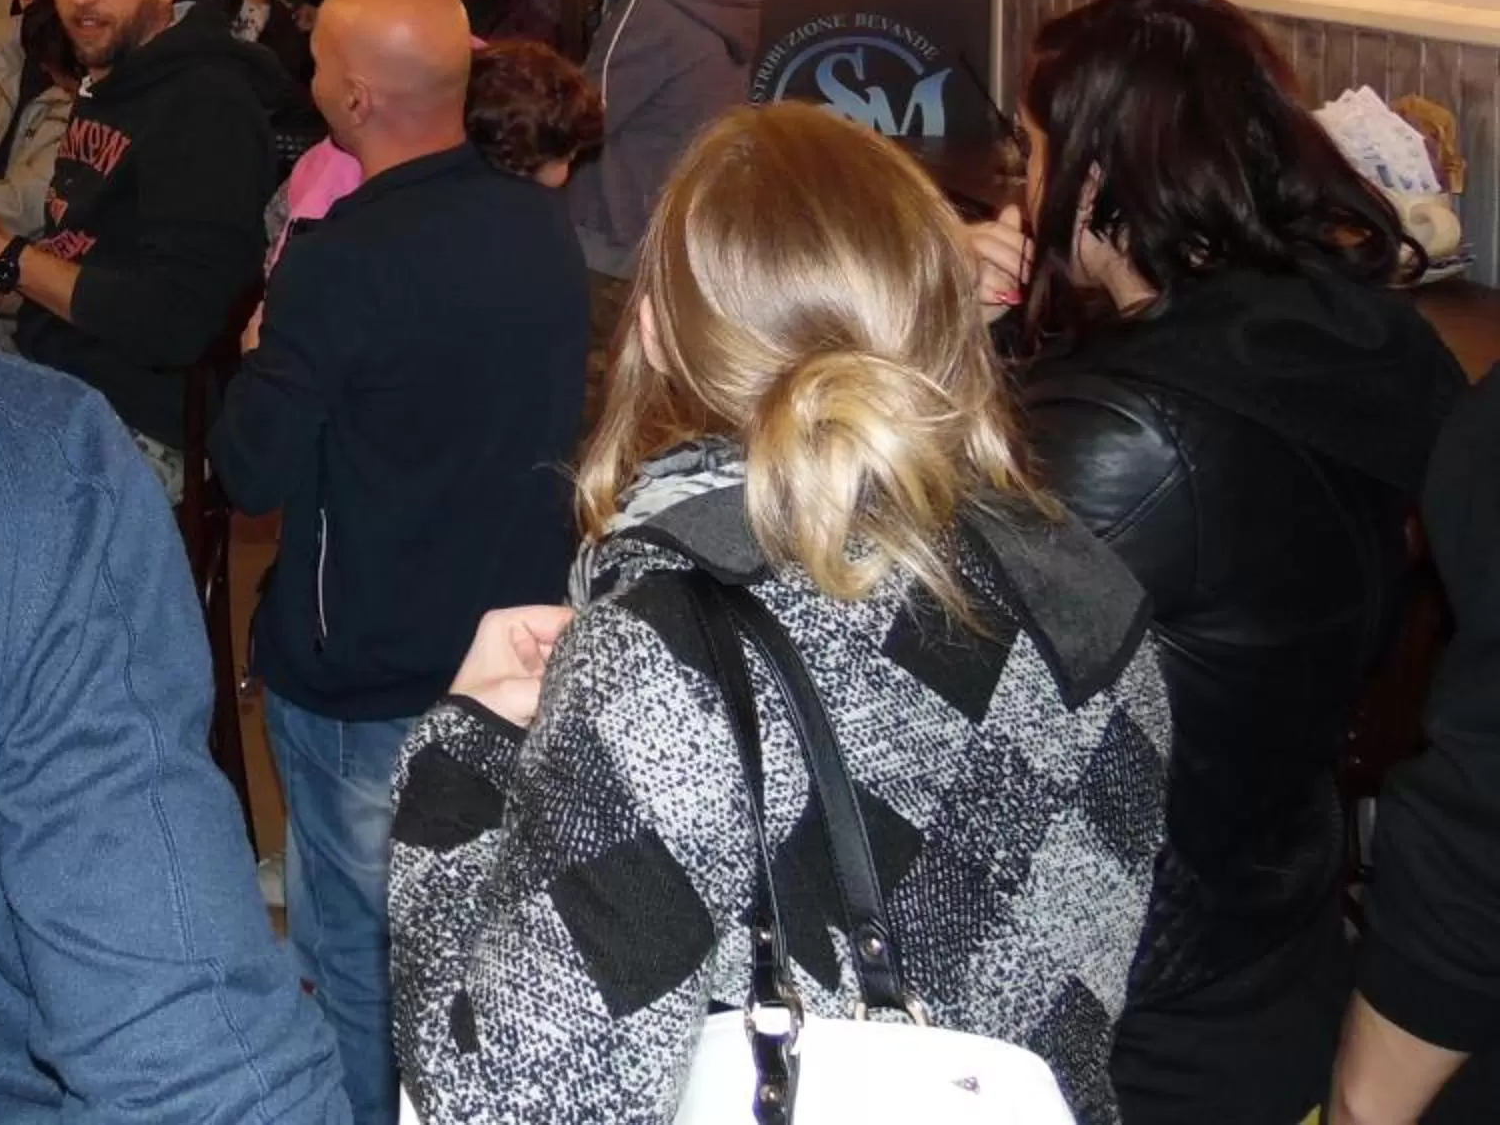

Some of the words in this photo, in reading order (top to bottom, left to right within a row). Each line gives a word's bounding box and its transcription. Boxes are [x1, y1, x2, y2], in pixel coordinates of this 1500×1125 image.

[750, 14, 848, 107] ISTRIBUZIONE
[854, 12, 940, 63] BEVANDE
[814, 46, 954, 137] SM
